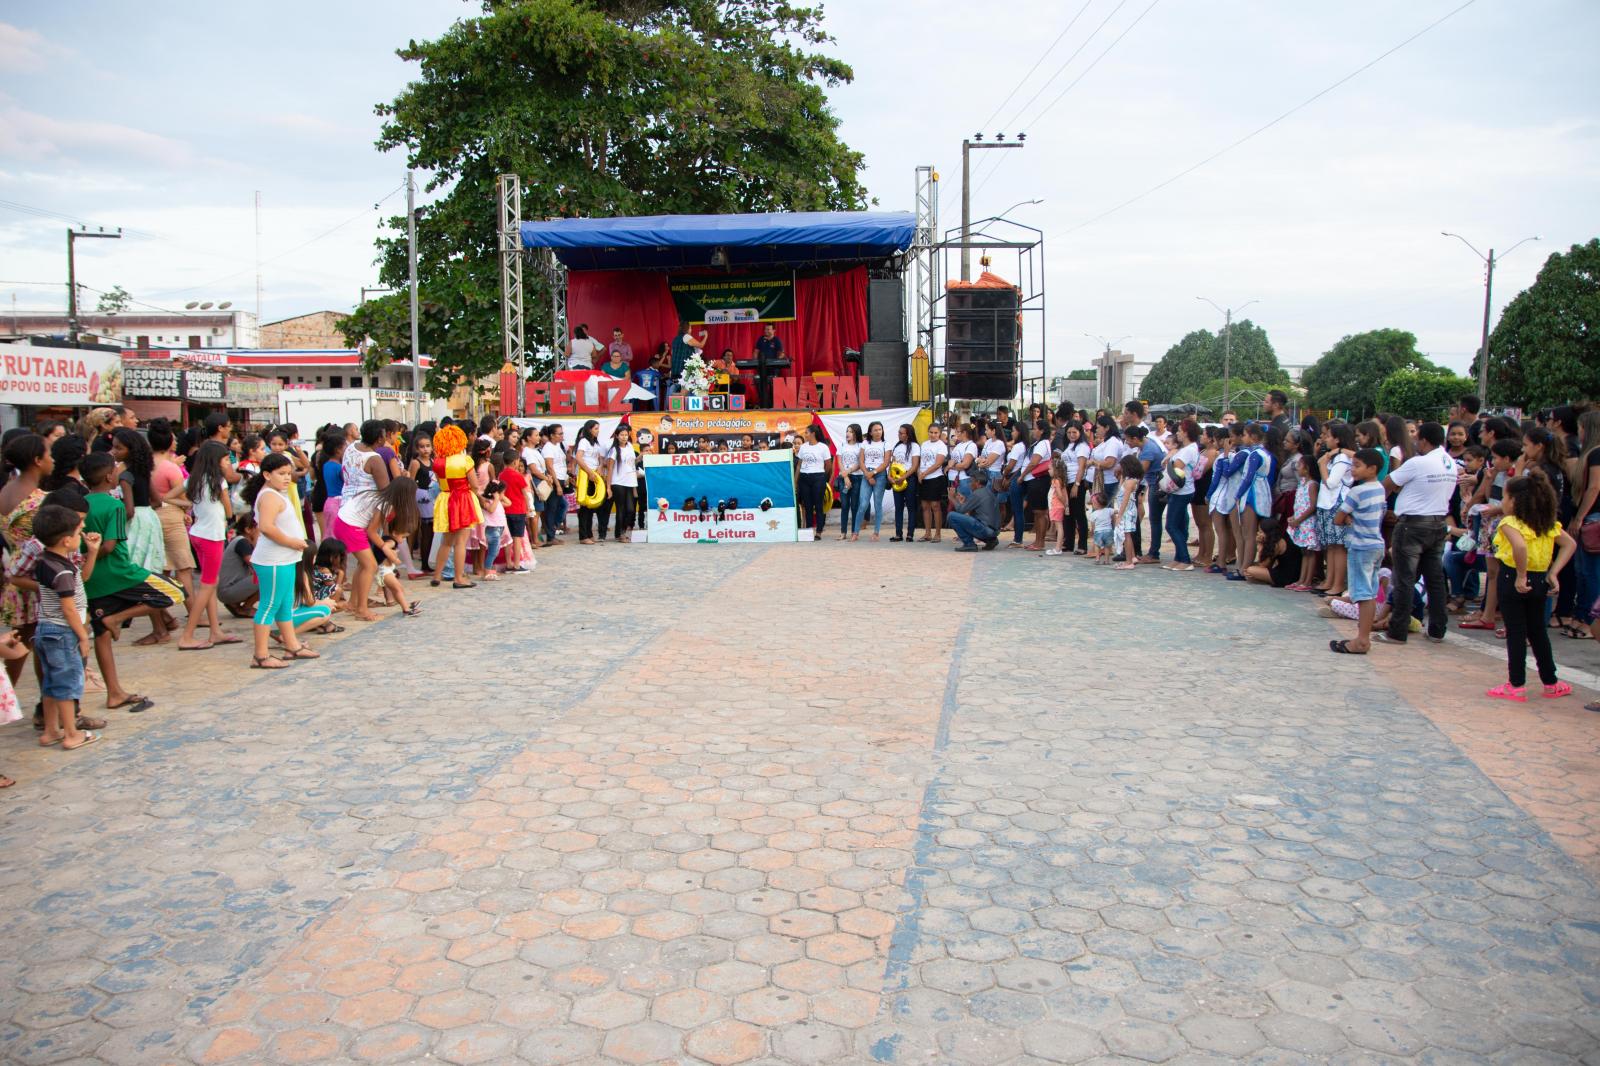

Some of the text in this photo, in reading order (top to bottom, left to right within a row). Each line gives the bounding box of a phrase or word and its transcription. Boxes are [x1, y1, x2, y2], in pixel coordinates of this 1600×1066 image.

[11, 381, 41, 393] POVO
[44, 382, 58, 393] DE
[61, 382, 88, 394] DEUS
[126, 379, 179, 388] RYAN
[187, 381, 219, 390] RYAN
[375, 390, 400, 398] RENATO
[525, 375, 883, 416] FELIZ NATAL
[707, 416, 752, 430] pedagógico
[671, 452, 760, 466] FANTOCHES
[683, 528, 756, 539] da Leitura
